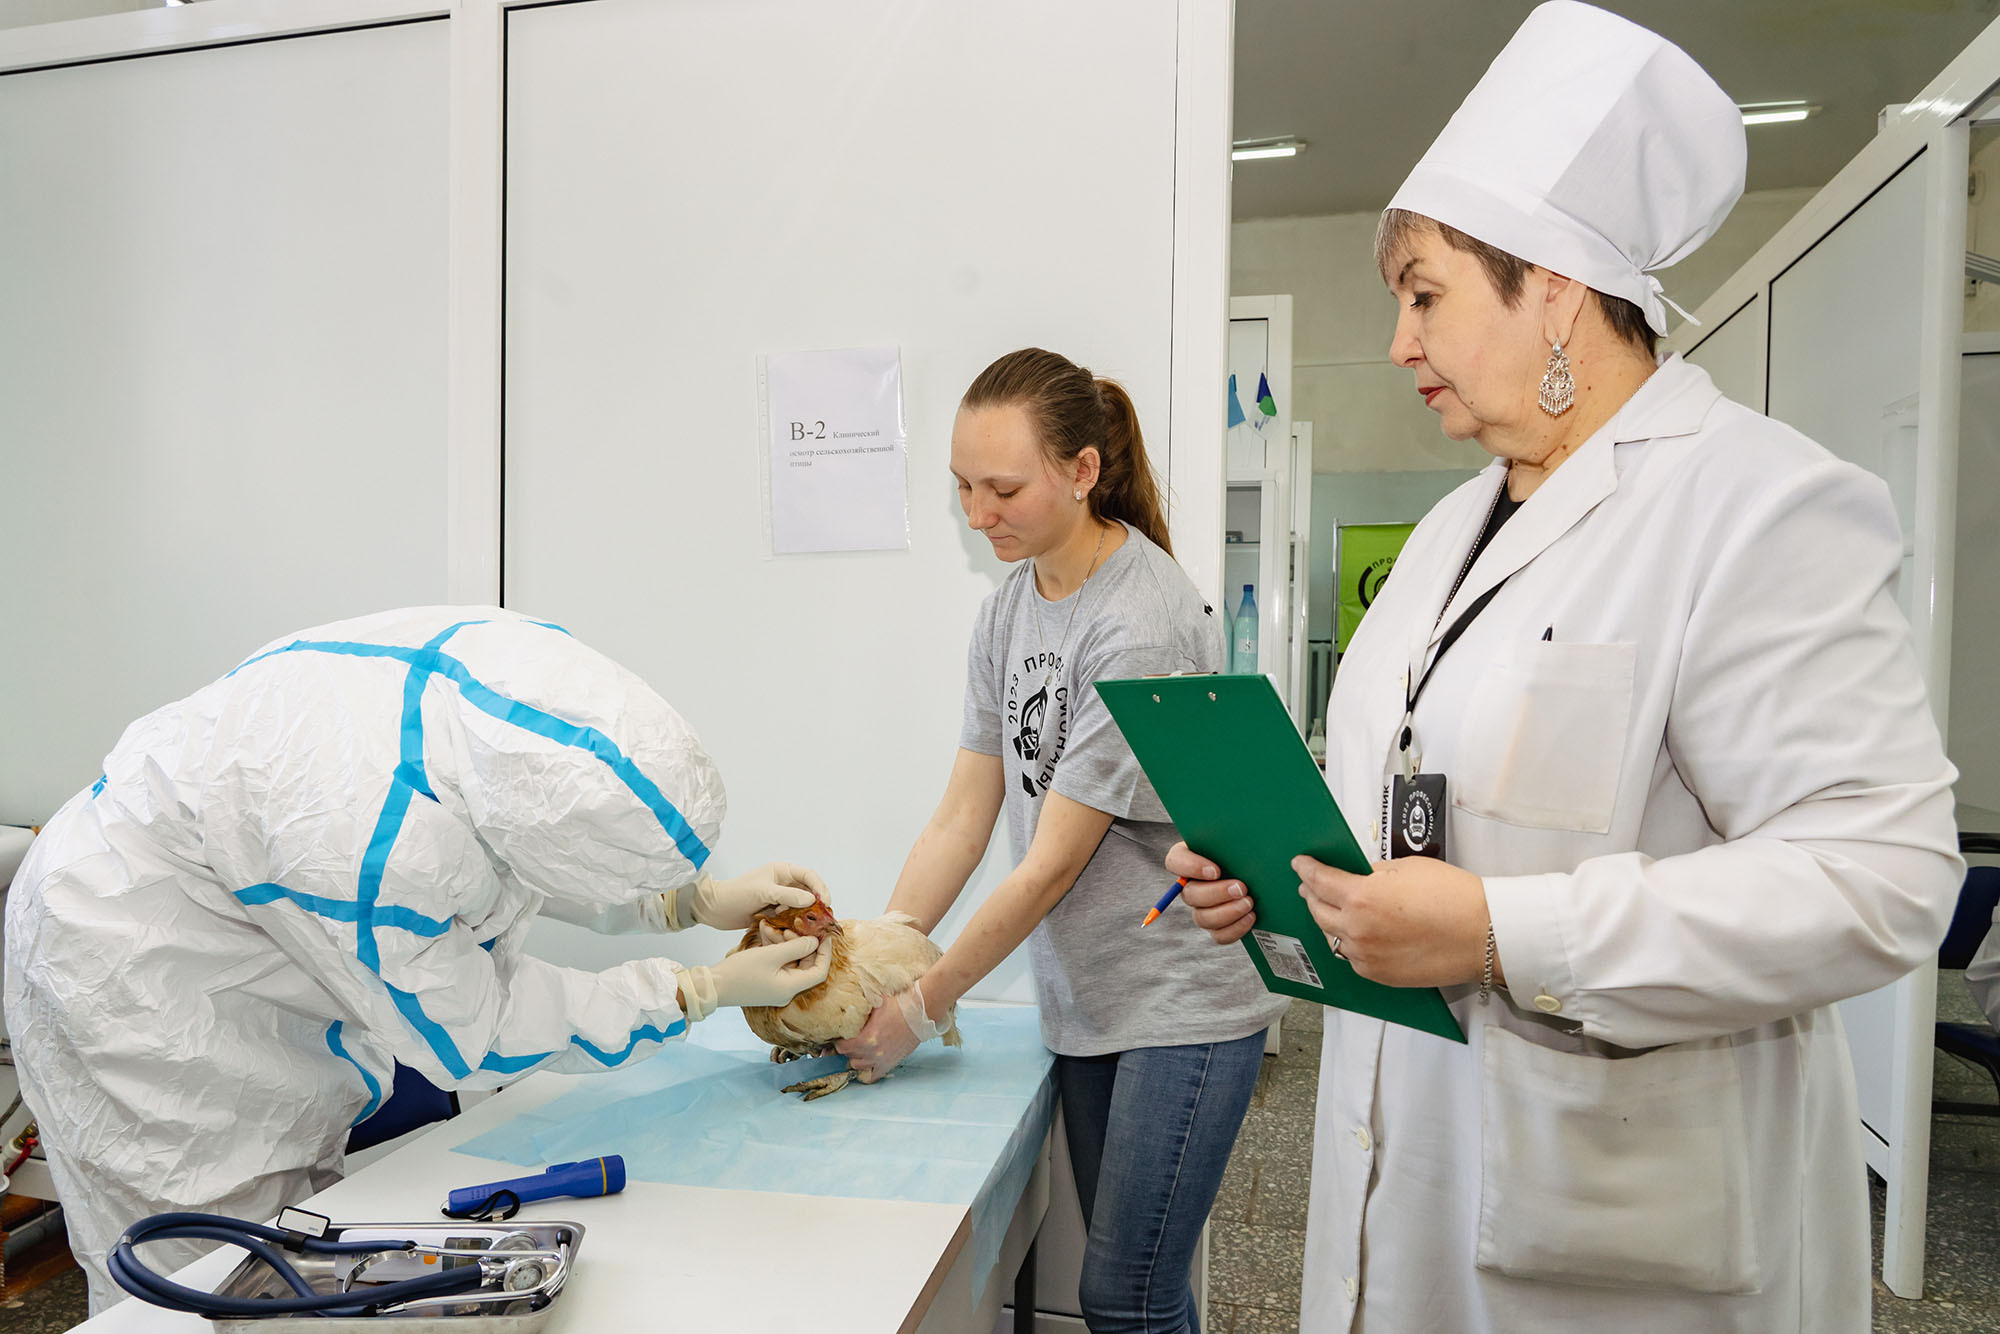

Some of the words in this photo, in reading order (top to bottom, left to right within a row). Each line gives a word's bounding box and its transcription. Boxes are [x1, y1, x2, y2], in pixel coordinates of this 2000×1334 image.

[790, 420, 826, 441] В-2
[833, 429, 880, 439] Клинический
[789, 449, 815, 457] осмотр
[816, 444, 894, 456] сельскохозяйственной
[1008, 673, 1019, 725] 2023
[1381, 785, 1390, 860] АСТАВНИК
